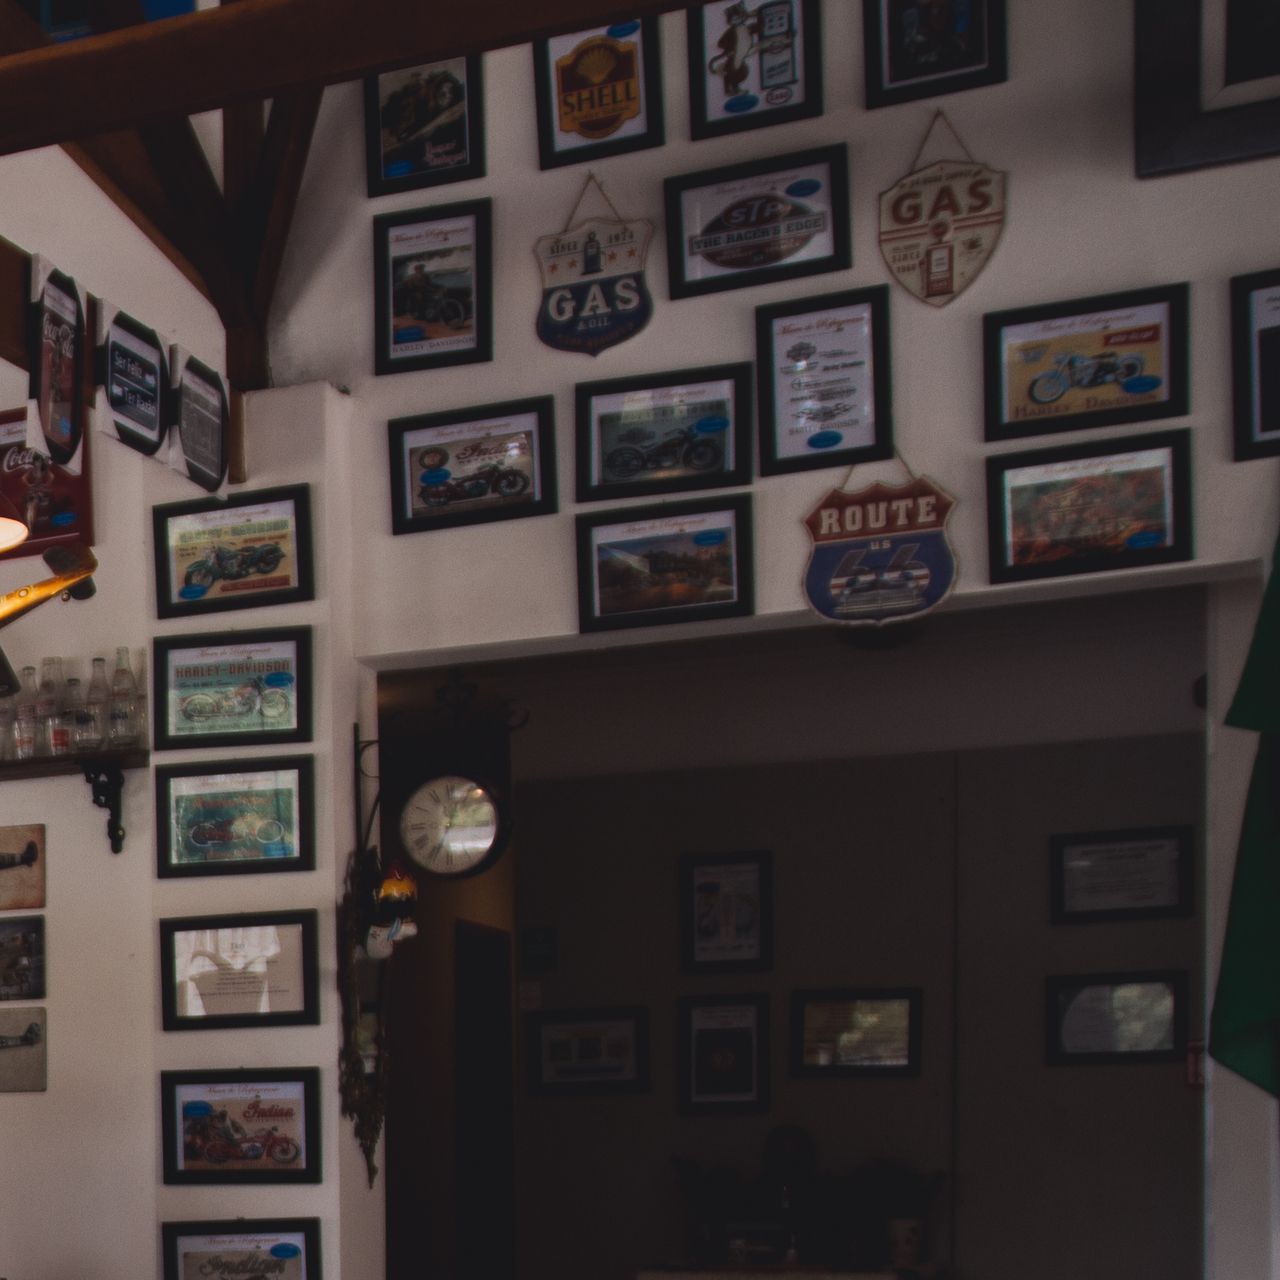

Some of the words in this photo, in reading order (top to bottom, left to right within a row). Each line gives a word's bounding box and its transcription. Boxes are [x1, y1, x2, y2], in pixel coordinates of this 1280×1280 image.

[562, 79, 637, 116] SHELL
[730, 198, 781, 224] STP
[891, 178, 993, 225] GAS
[694, 234, 720, 249] THE
[725, 225, 782, 244] RACER'S
[785, 217, 822, 232] EDGE
[548, 277, 641, 321] GAS
[820, 495, 937, 535] ROUTE
[830, 543, 931, 601] 66
[243, 1103, 294, 1119] Indian
